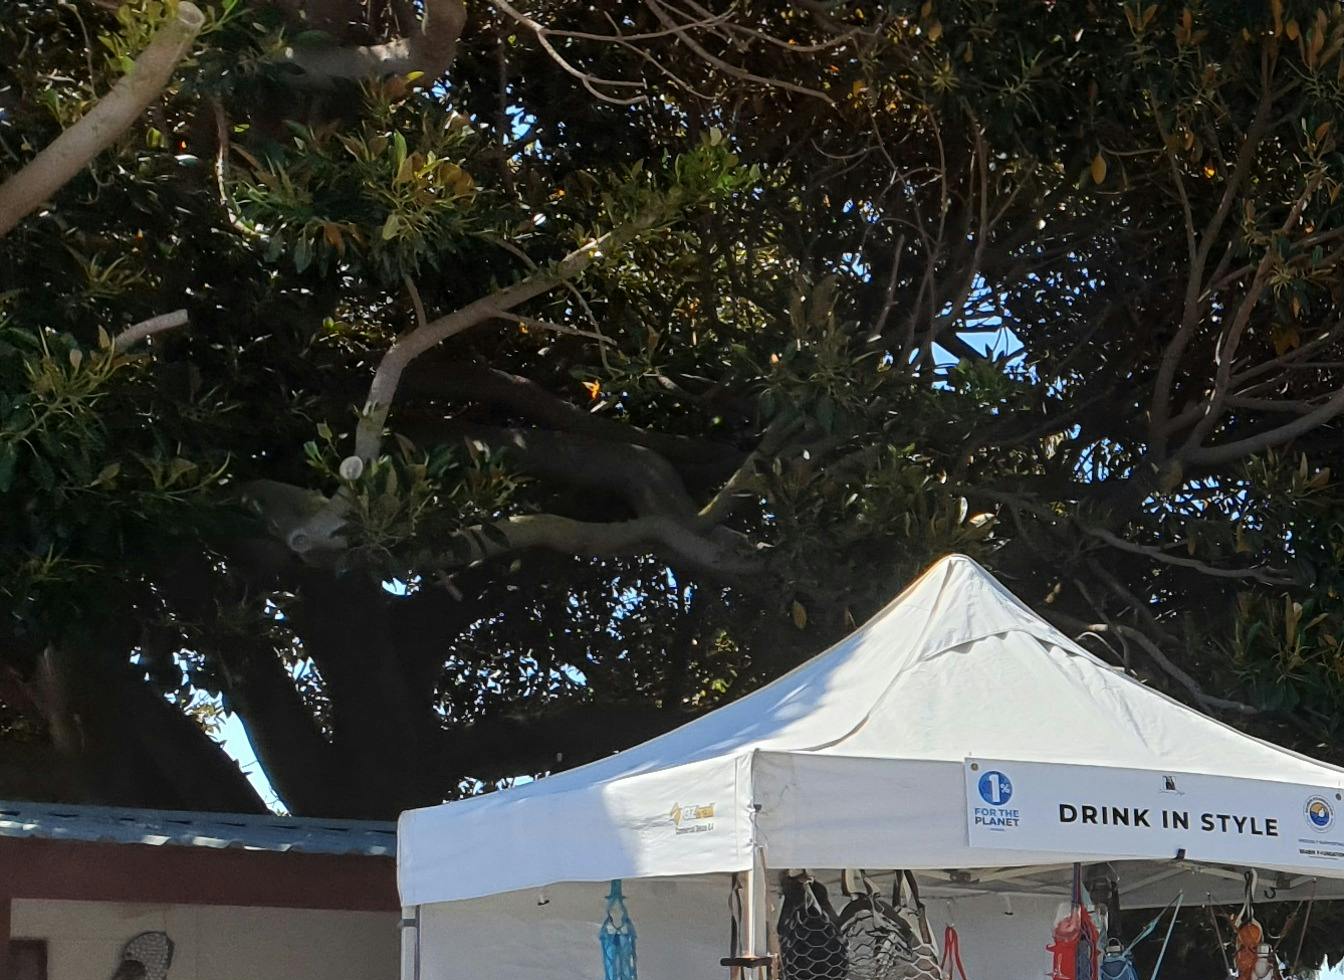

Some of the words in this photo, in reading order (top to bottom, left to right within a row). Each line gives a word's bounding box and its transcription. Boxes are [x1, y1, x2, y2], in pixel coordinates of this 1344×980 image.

[975, 807, 997, 817] FOR
[998, 809, 1019, 818] THE
[975, 816, 1019, 827] PLANET
[1059, 804, 1151, 828] DRINK
[1162, 810, 1188, 830] IN
[1201, 813, 1280, 837] STYLE
